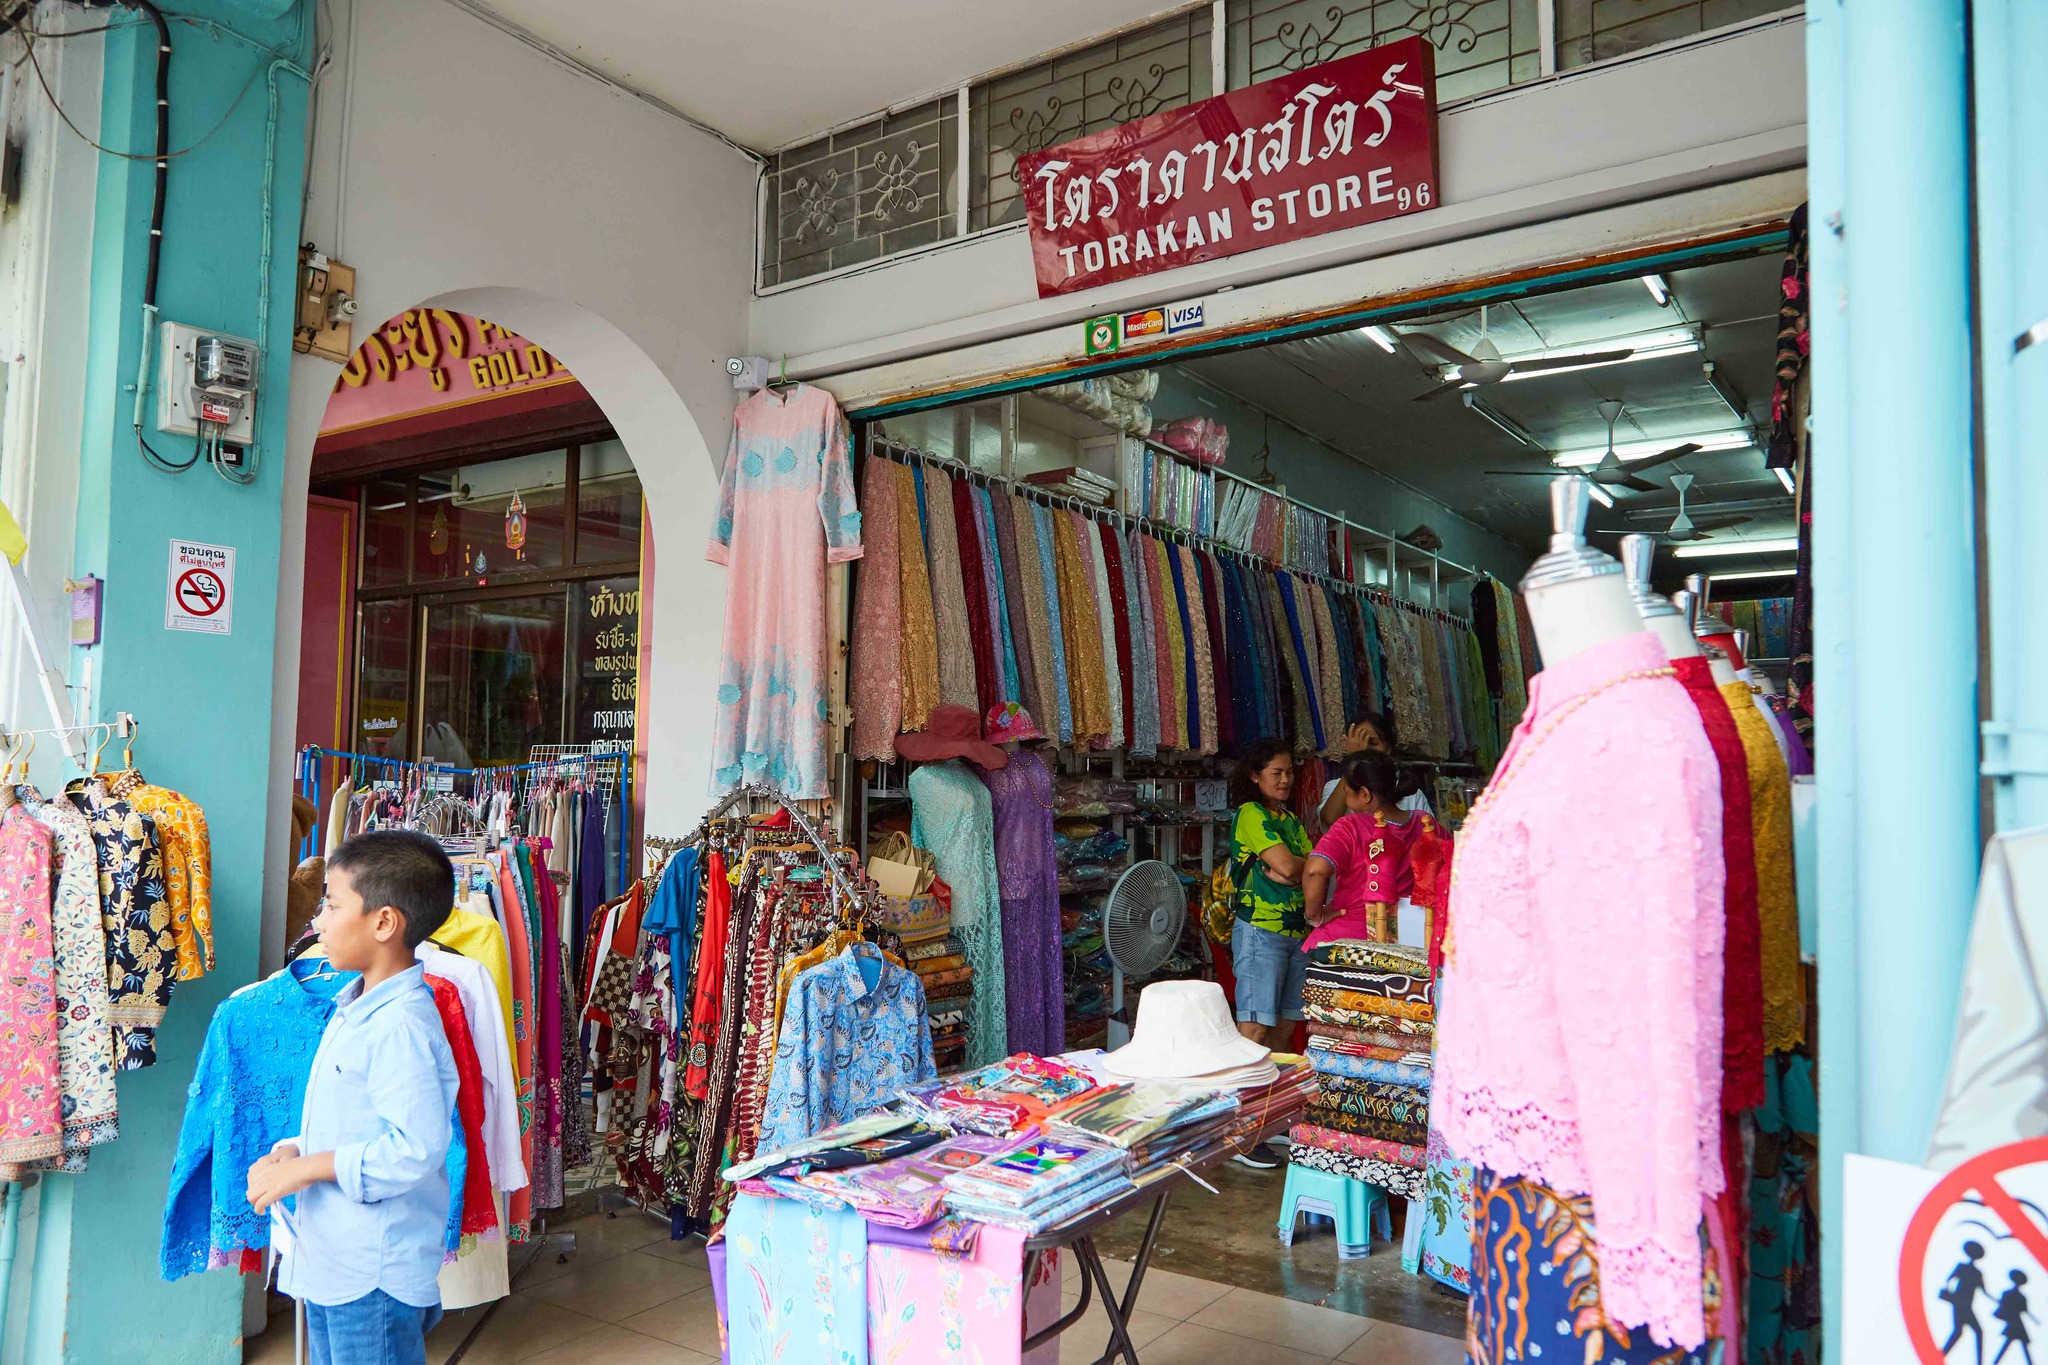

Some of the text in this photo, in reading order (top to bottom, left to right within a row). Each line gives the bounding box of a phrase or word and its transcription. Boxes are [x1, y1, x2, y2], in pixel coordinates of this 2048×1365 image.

[1034, 61, 1409, 232] โตราคานสโตร์
[1059, 165, 1431, 278] TORAKAN STORE 96
[1126, 317, 1164, 333] MasterCard
[1173, 305, 1203, 324] VISA
[468, 345, 549, 389] GOLD
[180, 545, 226, 561] ขอบคุณ
